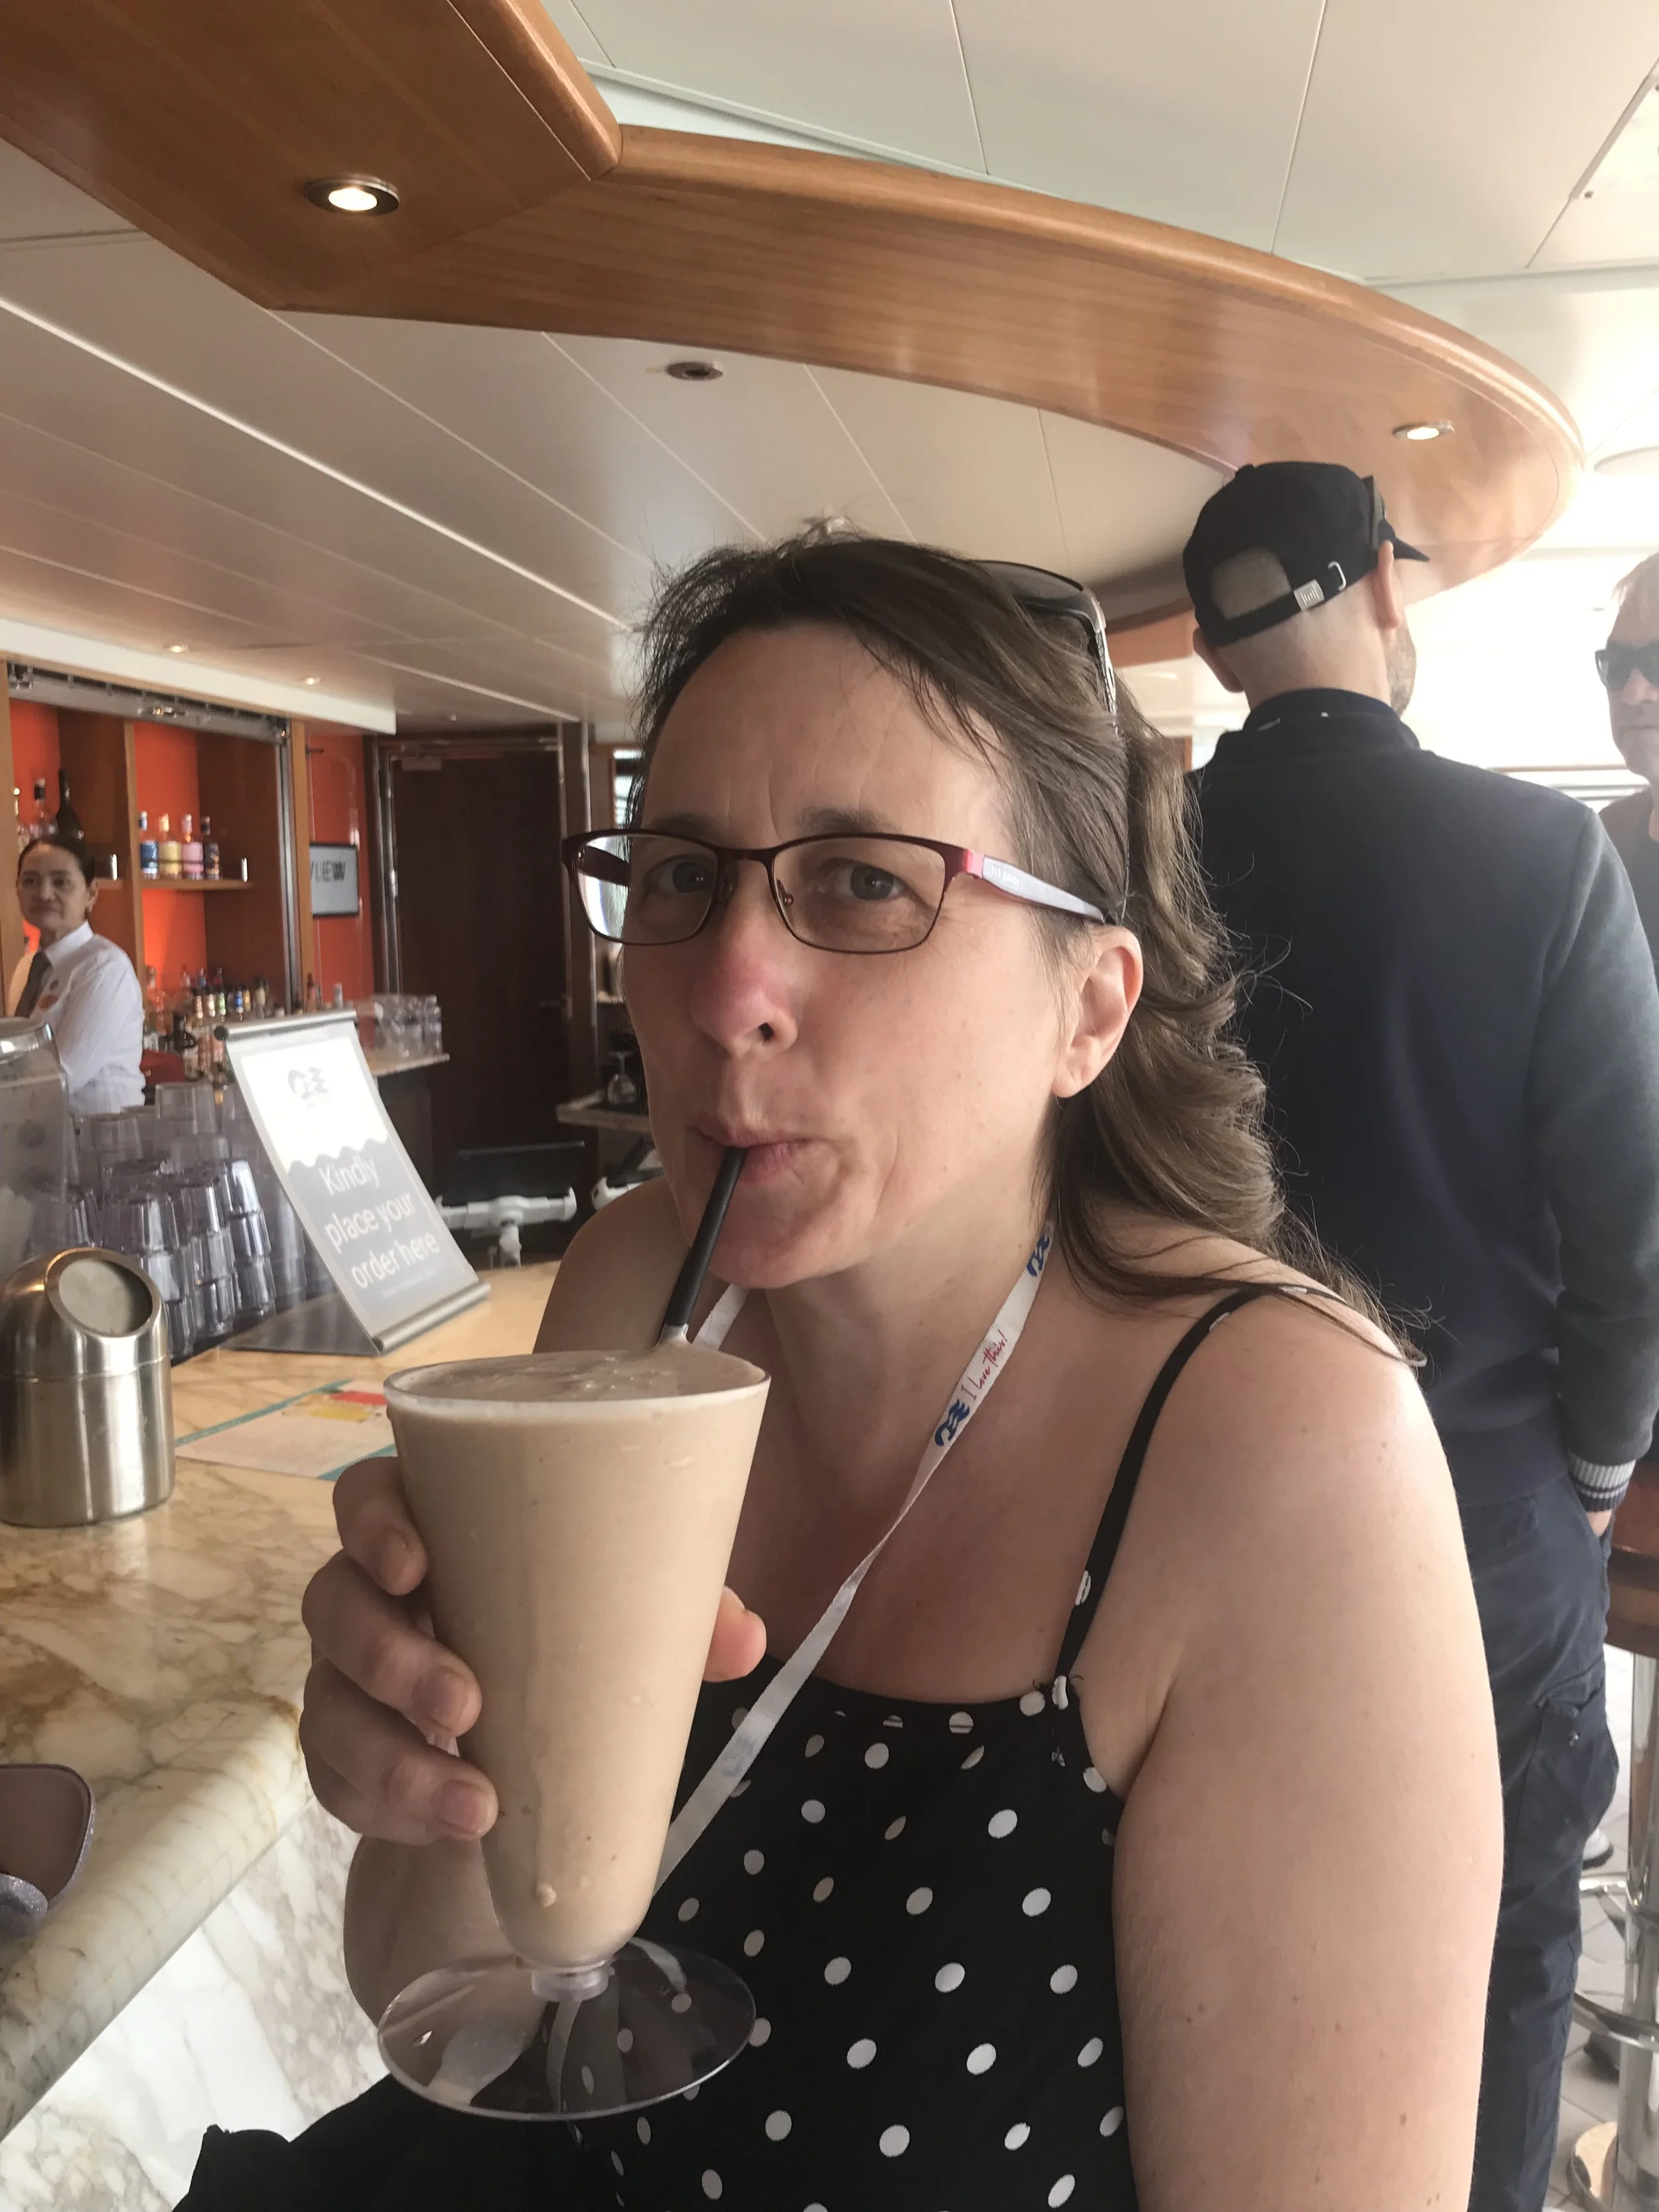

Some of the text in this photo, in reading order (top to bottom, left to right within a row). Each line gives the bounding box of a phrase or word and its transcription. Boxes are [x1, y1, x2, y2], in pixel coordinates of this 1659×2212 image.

[319, 1155, 380, 1196] Kindly
[325, 1193, 415, 1254] place your
[352, 1249, 400, 1289] order
[394, 1232, 440, 1266] here
[961, 1383, 977, 1402] I
